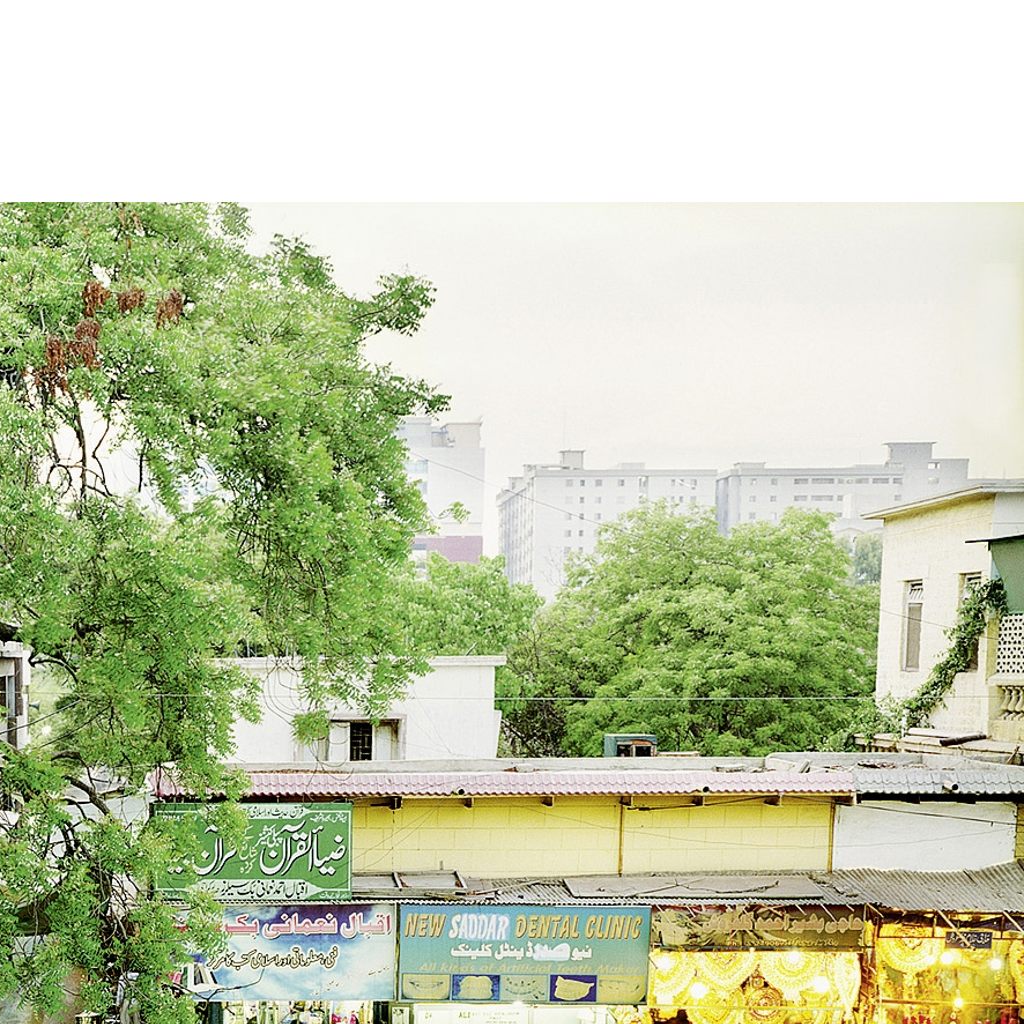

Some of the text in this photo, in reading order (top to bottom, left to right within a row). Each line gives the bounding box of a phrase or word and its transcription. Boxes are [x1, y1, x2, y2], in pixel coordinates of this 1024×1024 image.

[262, 912, 338, 939] نعمانی
[340, 913, 392, 939] اقبال
[404, 913, 643, 940] NEW SADDAR DENTAL CLINIC
[451, 943, 493, 959] کلینک
[571, 943, 592, 961] نیو
[479, 963, 495, 972] of
